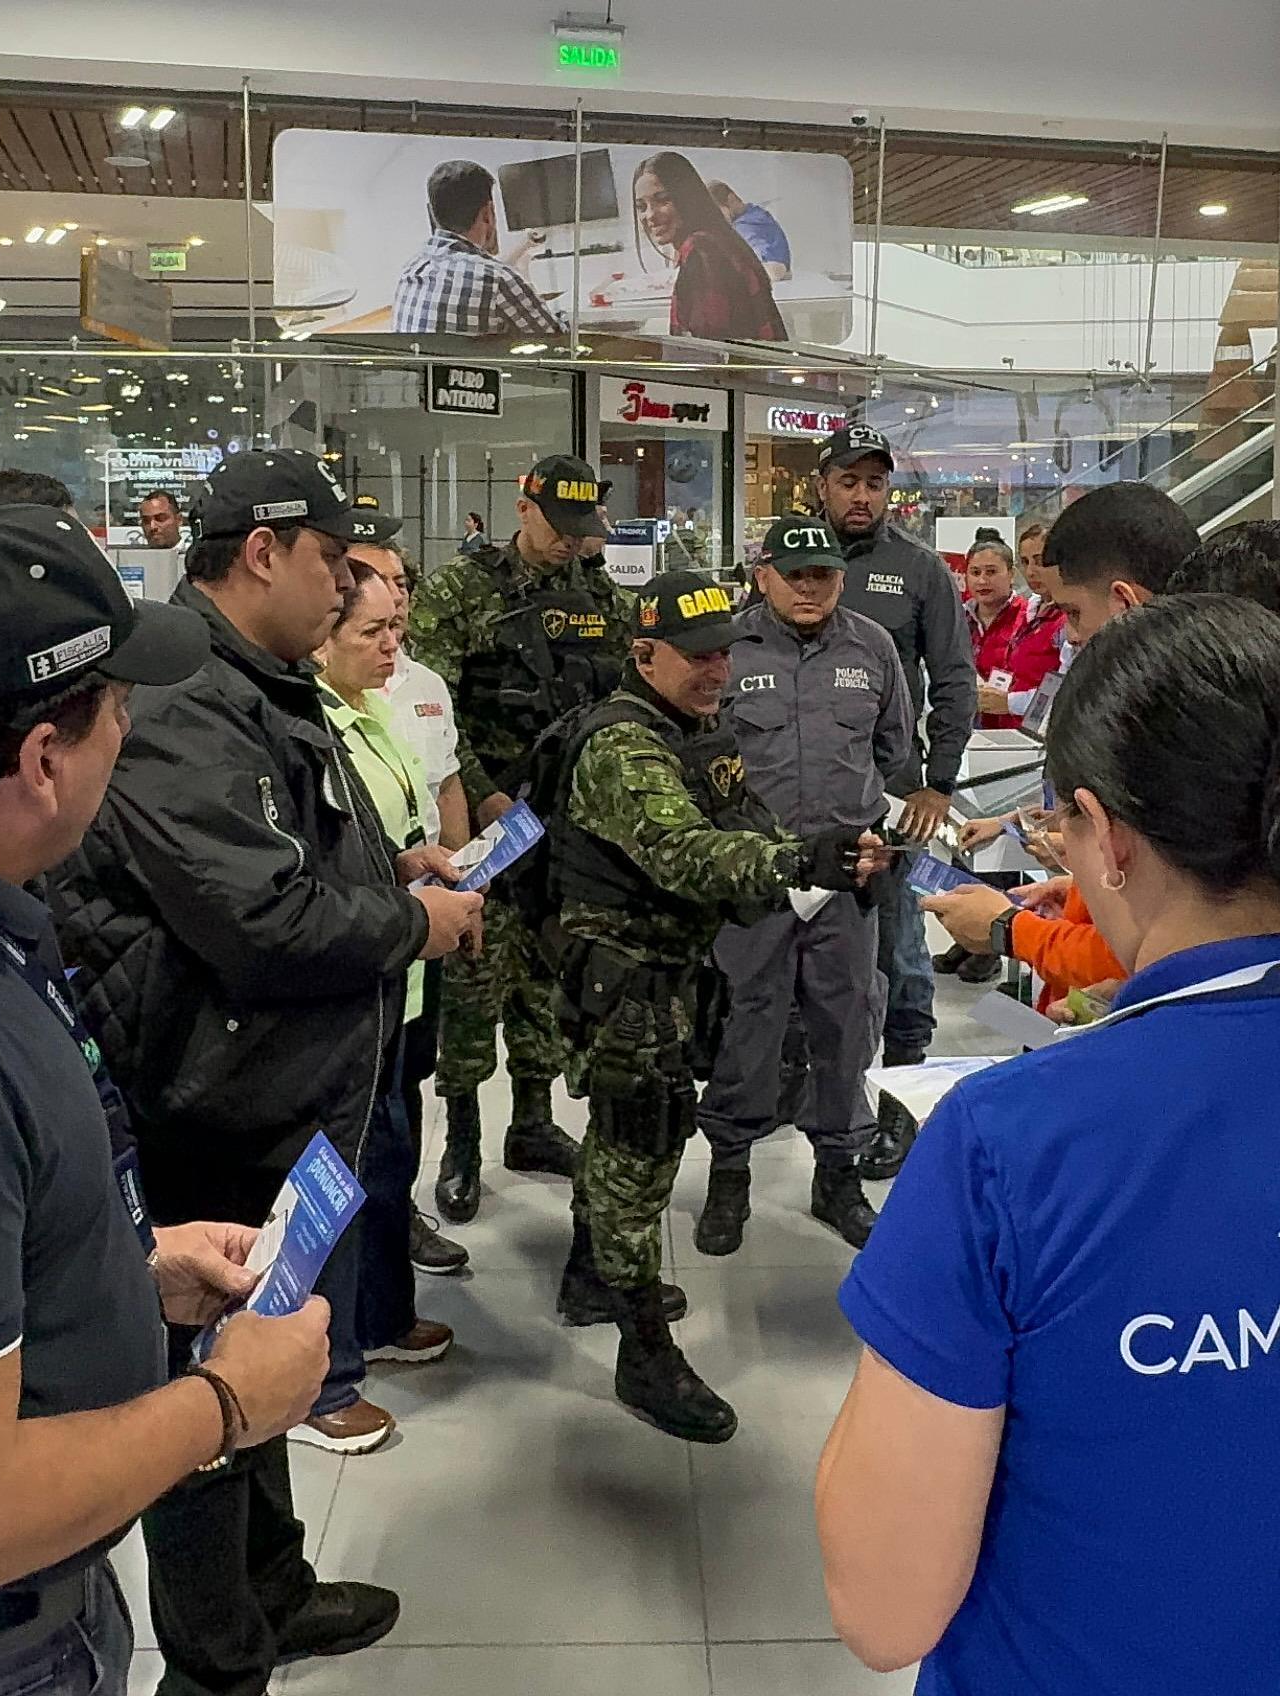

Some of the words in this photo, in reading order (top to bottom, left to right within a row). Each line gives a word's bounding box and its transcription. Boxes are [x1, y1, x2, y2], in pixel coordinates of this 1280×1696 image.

[560, 45, 617, 67] SALIDA
[449, 368, 485, 389] PURO
[436, 388, 496, 410] INTERIOR
[783, 528, 830, 549] CTI
[609, 565, 646, 575] SALIDA
[740, 674, 776, 692] CTI
